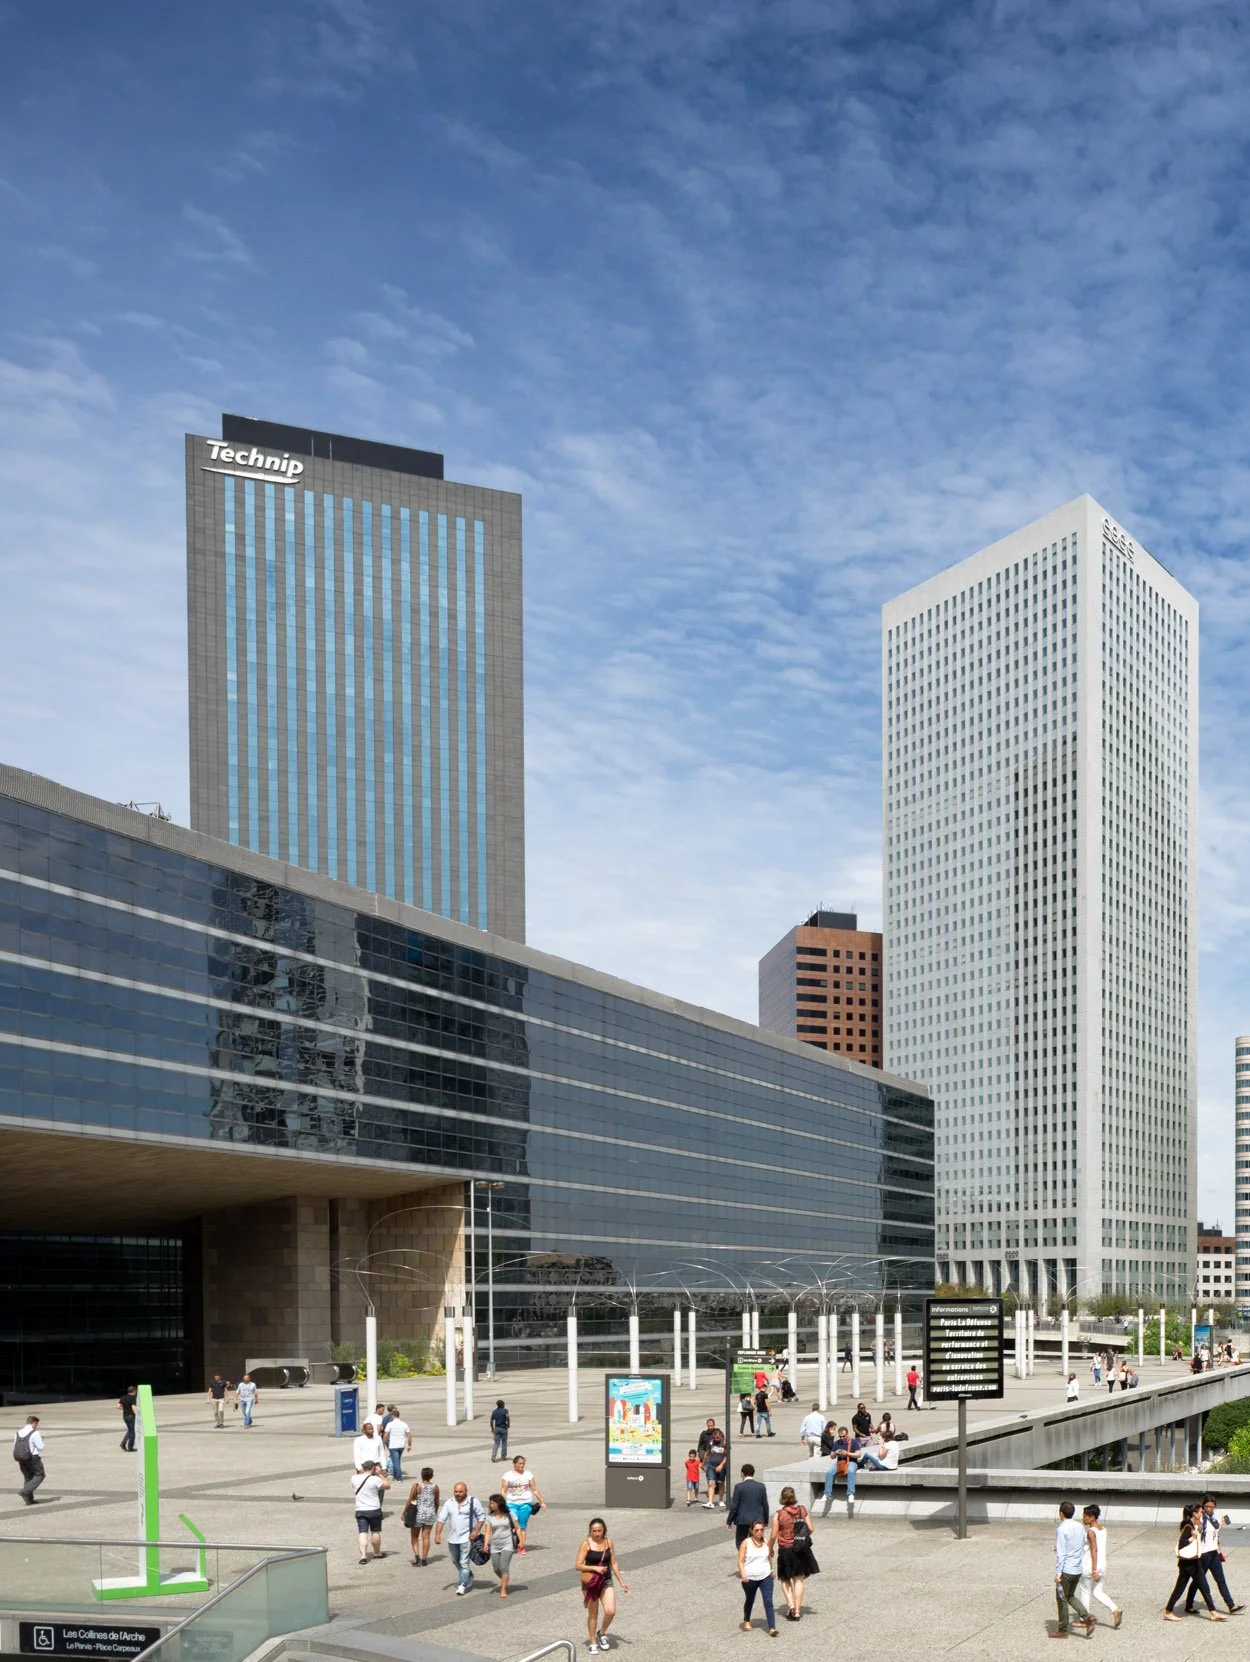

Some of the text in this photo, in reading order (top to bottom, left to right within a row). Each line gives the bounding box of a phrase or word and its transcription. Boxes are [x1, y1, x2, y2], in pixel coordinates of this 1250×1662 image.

[206, 439, 304, 478] Technip
[940, 1318, 957, 1326] Paris
[958, 1318, 966, 1326] La
[945, 1329, 976, 1337] Territoire
[62, 1628, 146, 1642] Les Collines de l'Arche
[74, 1642, 92, 1651] Parvis
[95, 1643, 112, 1651] Place
